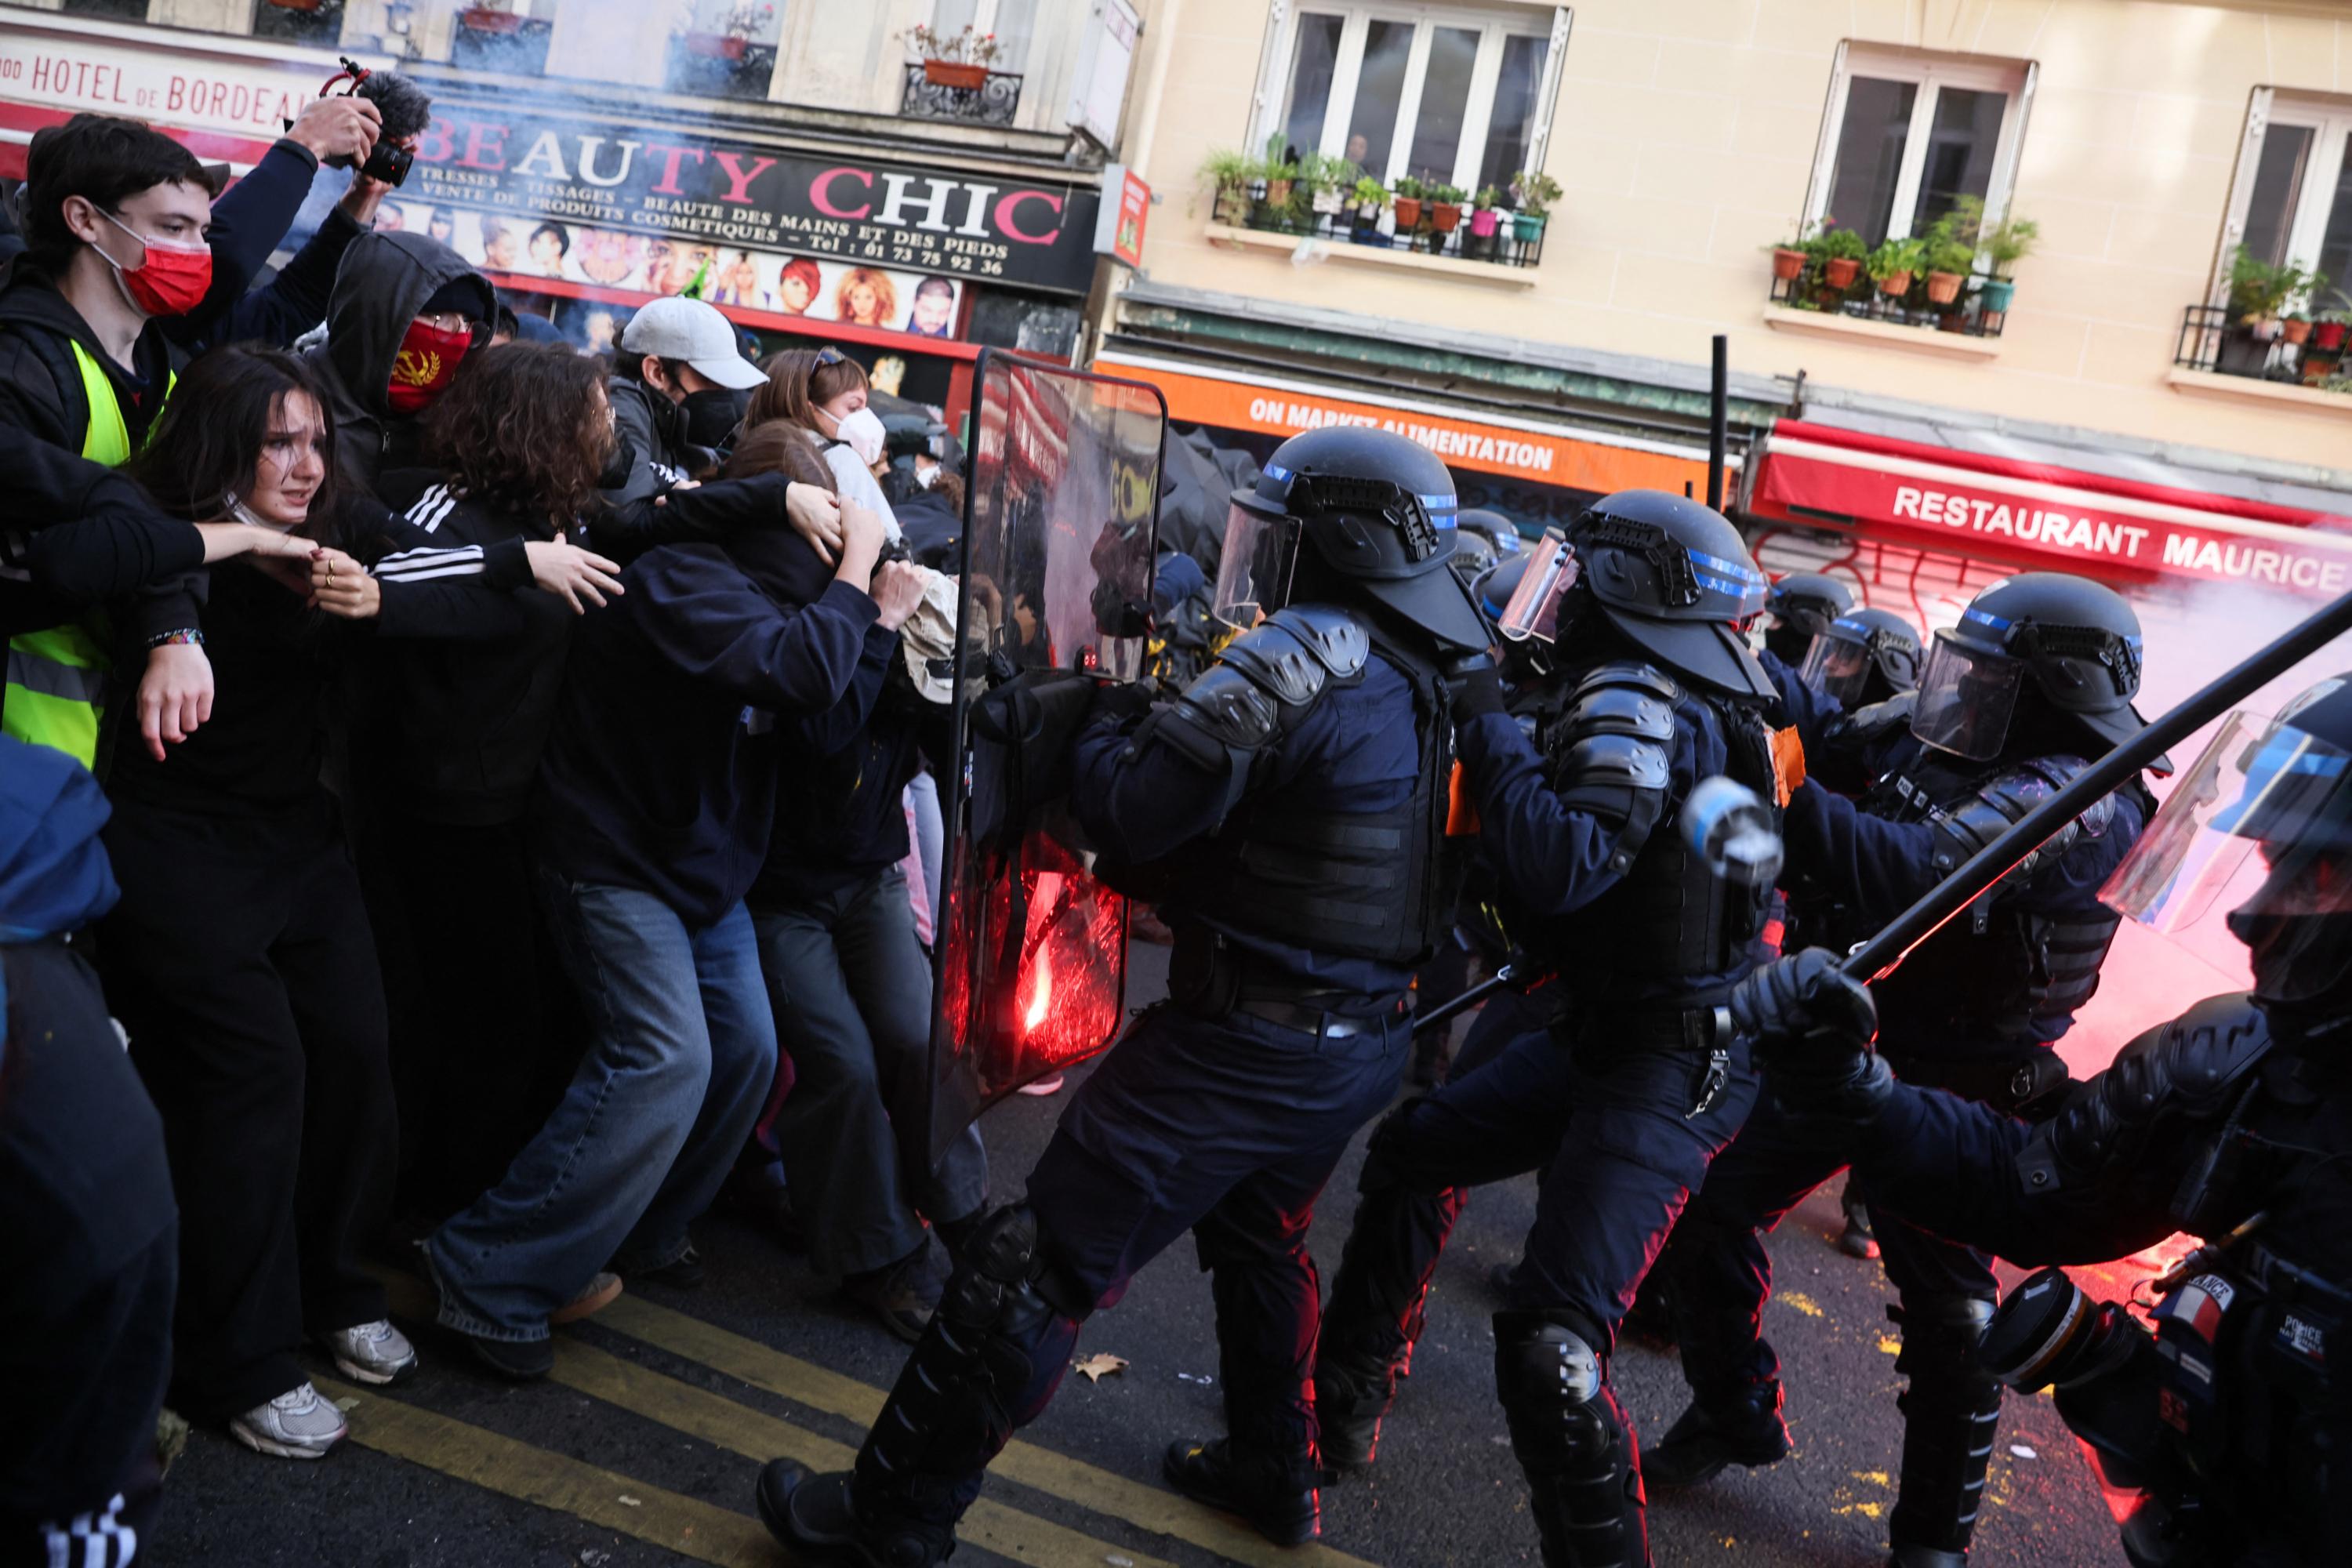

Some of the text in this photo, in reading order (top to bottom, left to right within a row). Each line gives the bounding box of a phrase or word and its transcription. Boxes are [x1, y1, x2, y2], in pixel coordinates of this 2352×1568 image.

[0, 57, 22, 80] 00
[31, 55, 127, 103] HOTEL
[136, 87, 159, 109] DE
[413, 115, 778, 204] BEAUTY
[808, 166, 1063, 246] CHIC
[420, 166, 499, 189] TRESSES
[527, 181, 616, 205] TISSAGES
[644, 196, 724, 219] BEAUTE
[731, 207, 773, 227] DES
[779, 215, 850, 237] MAINS
[858, 225, 887, 242] ET
[892, 230, 936, 249] DES
[943, 236, 1009, 260] PIEDS
[422, 180, 487, 201] VENTE
[493, 191, 519, 205] DE
[527, 196, 626, 222] PRODUITS
[631, 209, 780, 244] COSMETIQUES
[864, 241, 885, 259] 01
[892, 246, 913, 263] 73
[921, 251, 942, 267] 75
[950, 256, 973, 272] 92
[979, 260, 1004, 276] 36
[1249, 397, 1285, 424] ON
[1893, 486, 2350, 592] RESTAURANT MAURICE
